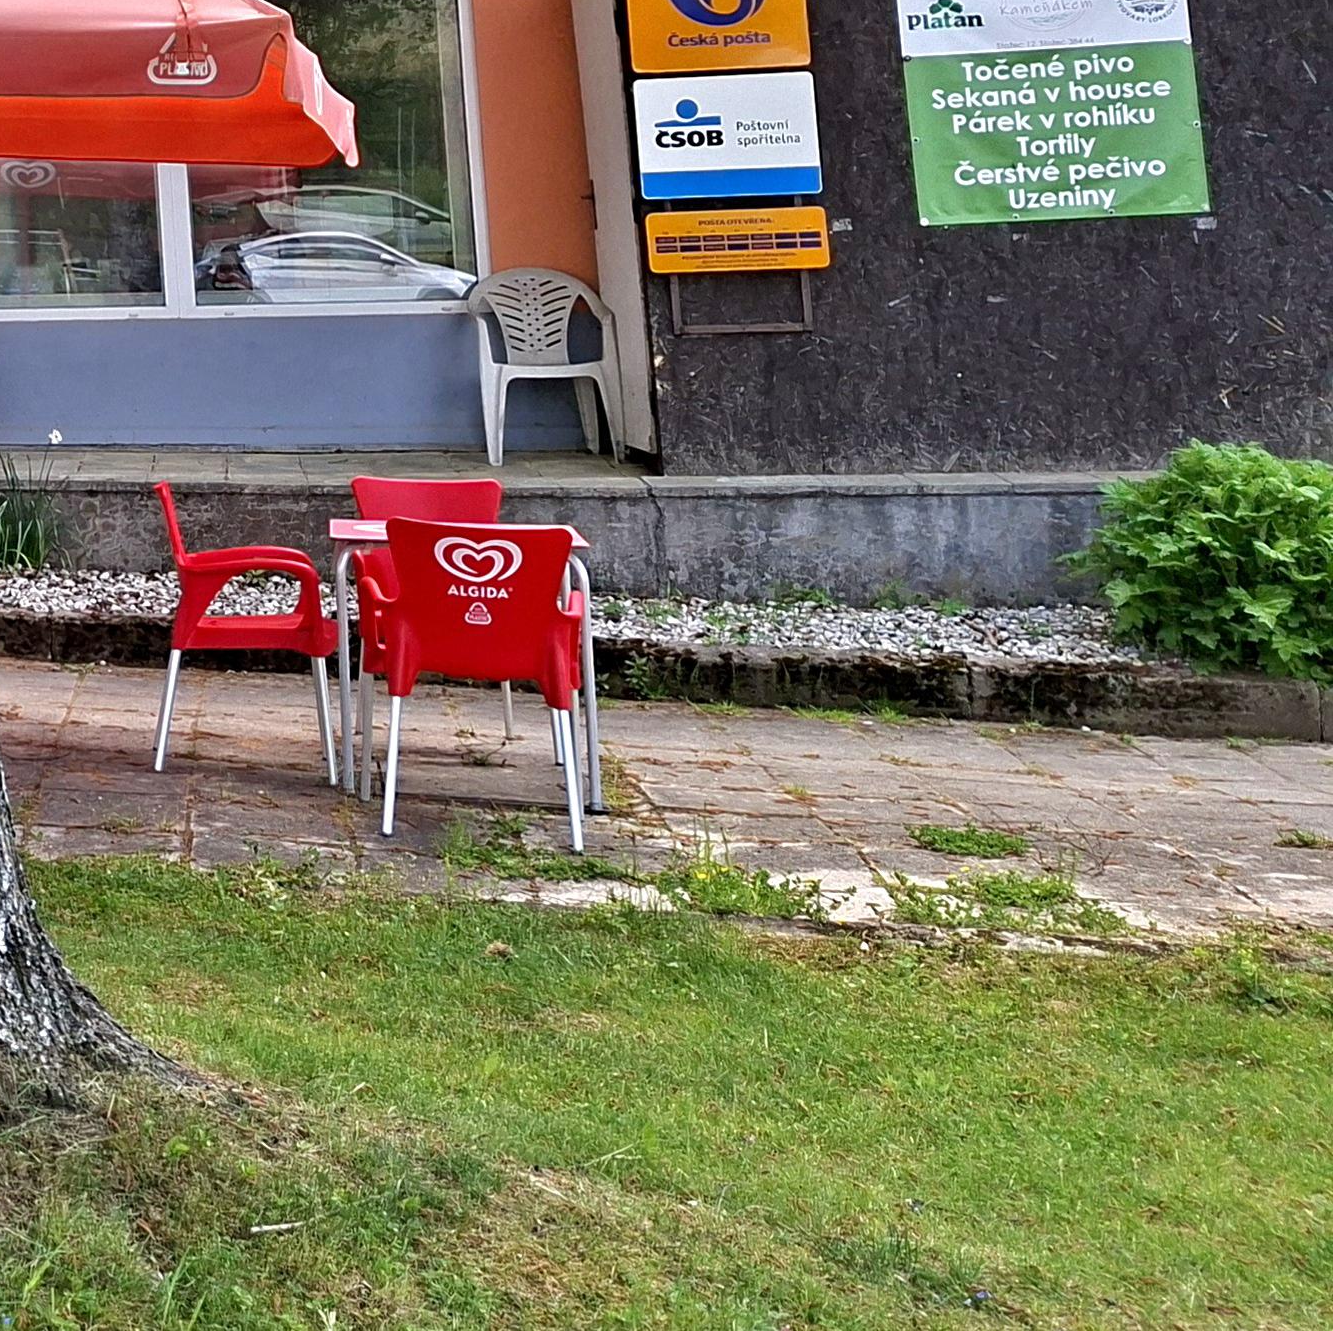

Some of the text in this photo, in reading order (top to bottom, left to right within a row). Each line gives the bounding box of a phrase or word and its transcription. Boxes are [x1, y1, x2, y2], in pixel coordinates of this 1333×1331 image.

[906, 11, 984, 31] Platan
[668, 31, 771, 48] Česká pošta
[961, 53, 1134, 83] Točené pivo
[932, 80, 1172, 109] Sekaná v housce
[736, 119, 790, 131] Poštovní
[952, 102, 1155, 134] Párek v rohlíku
[655, 130, 724, 148] ČSOB
[737, 135, 800, 147] spořitelna
[1016, 133, 1096, 158] Tortily
[954, 156, 1166, 186] Čerstvé pečivo
[1009, 185, 1115, 210] Uzeniny
[447, 584, 510, 599] ALGIDA
